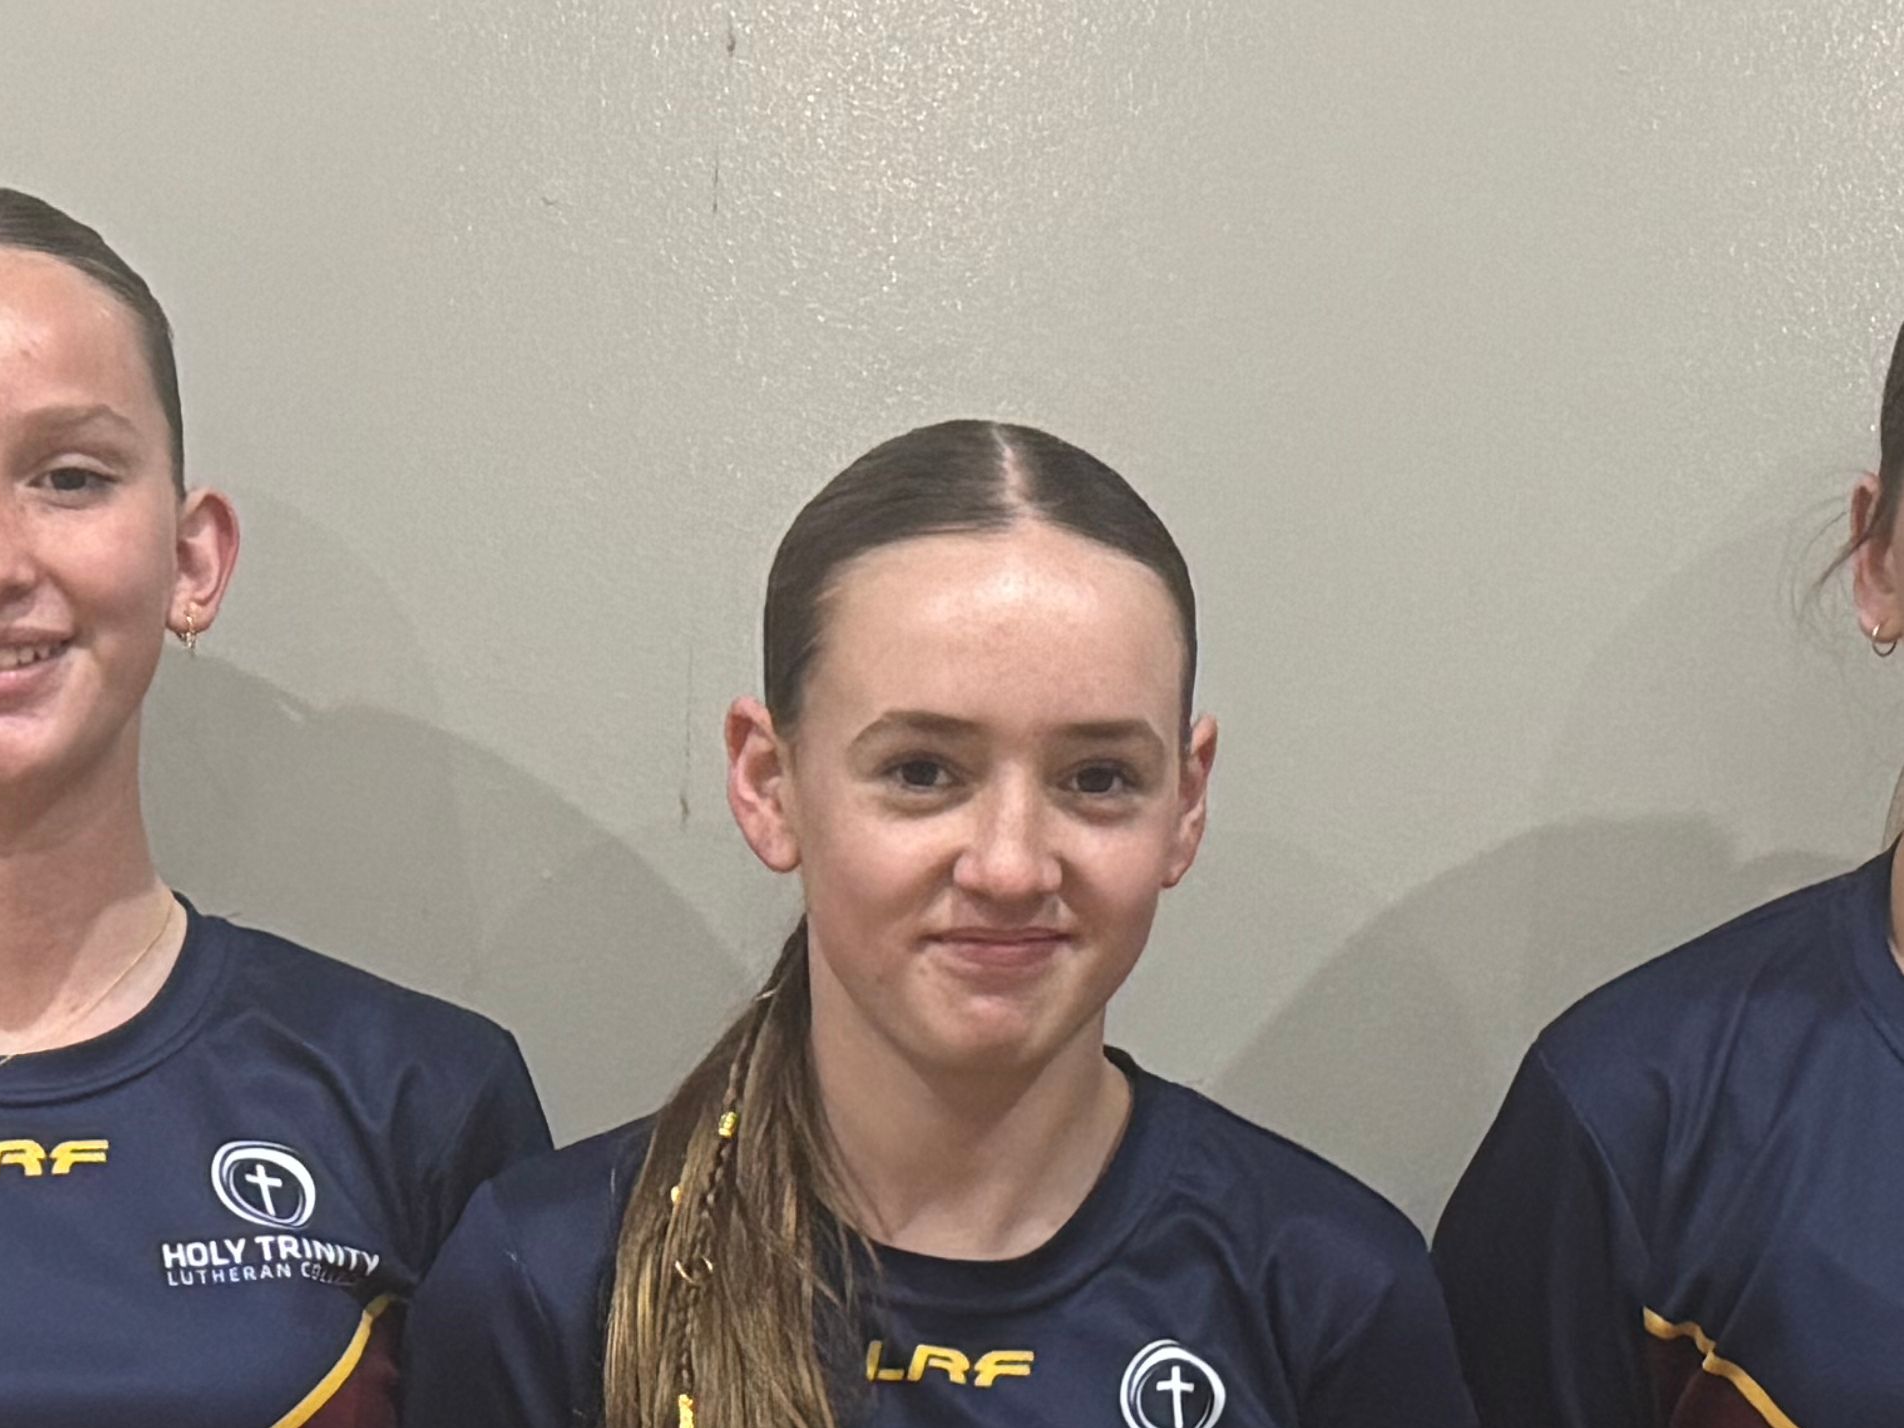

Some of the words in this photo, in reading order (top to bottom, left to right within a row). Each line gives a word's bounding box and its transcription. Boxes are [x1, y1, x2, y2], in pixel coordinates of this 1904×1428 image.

[161, 1237, 246, 1269] HOLY
[253, 1234, 380, 1277] TRINITY
[167, 1262, 292, 1287] LUTHERAN
[865, 1339, 1035, 1388] LRF
